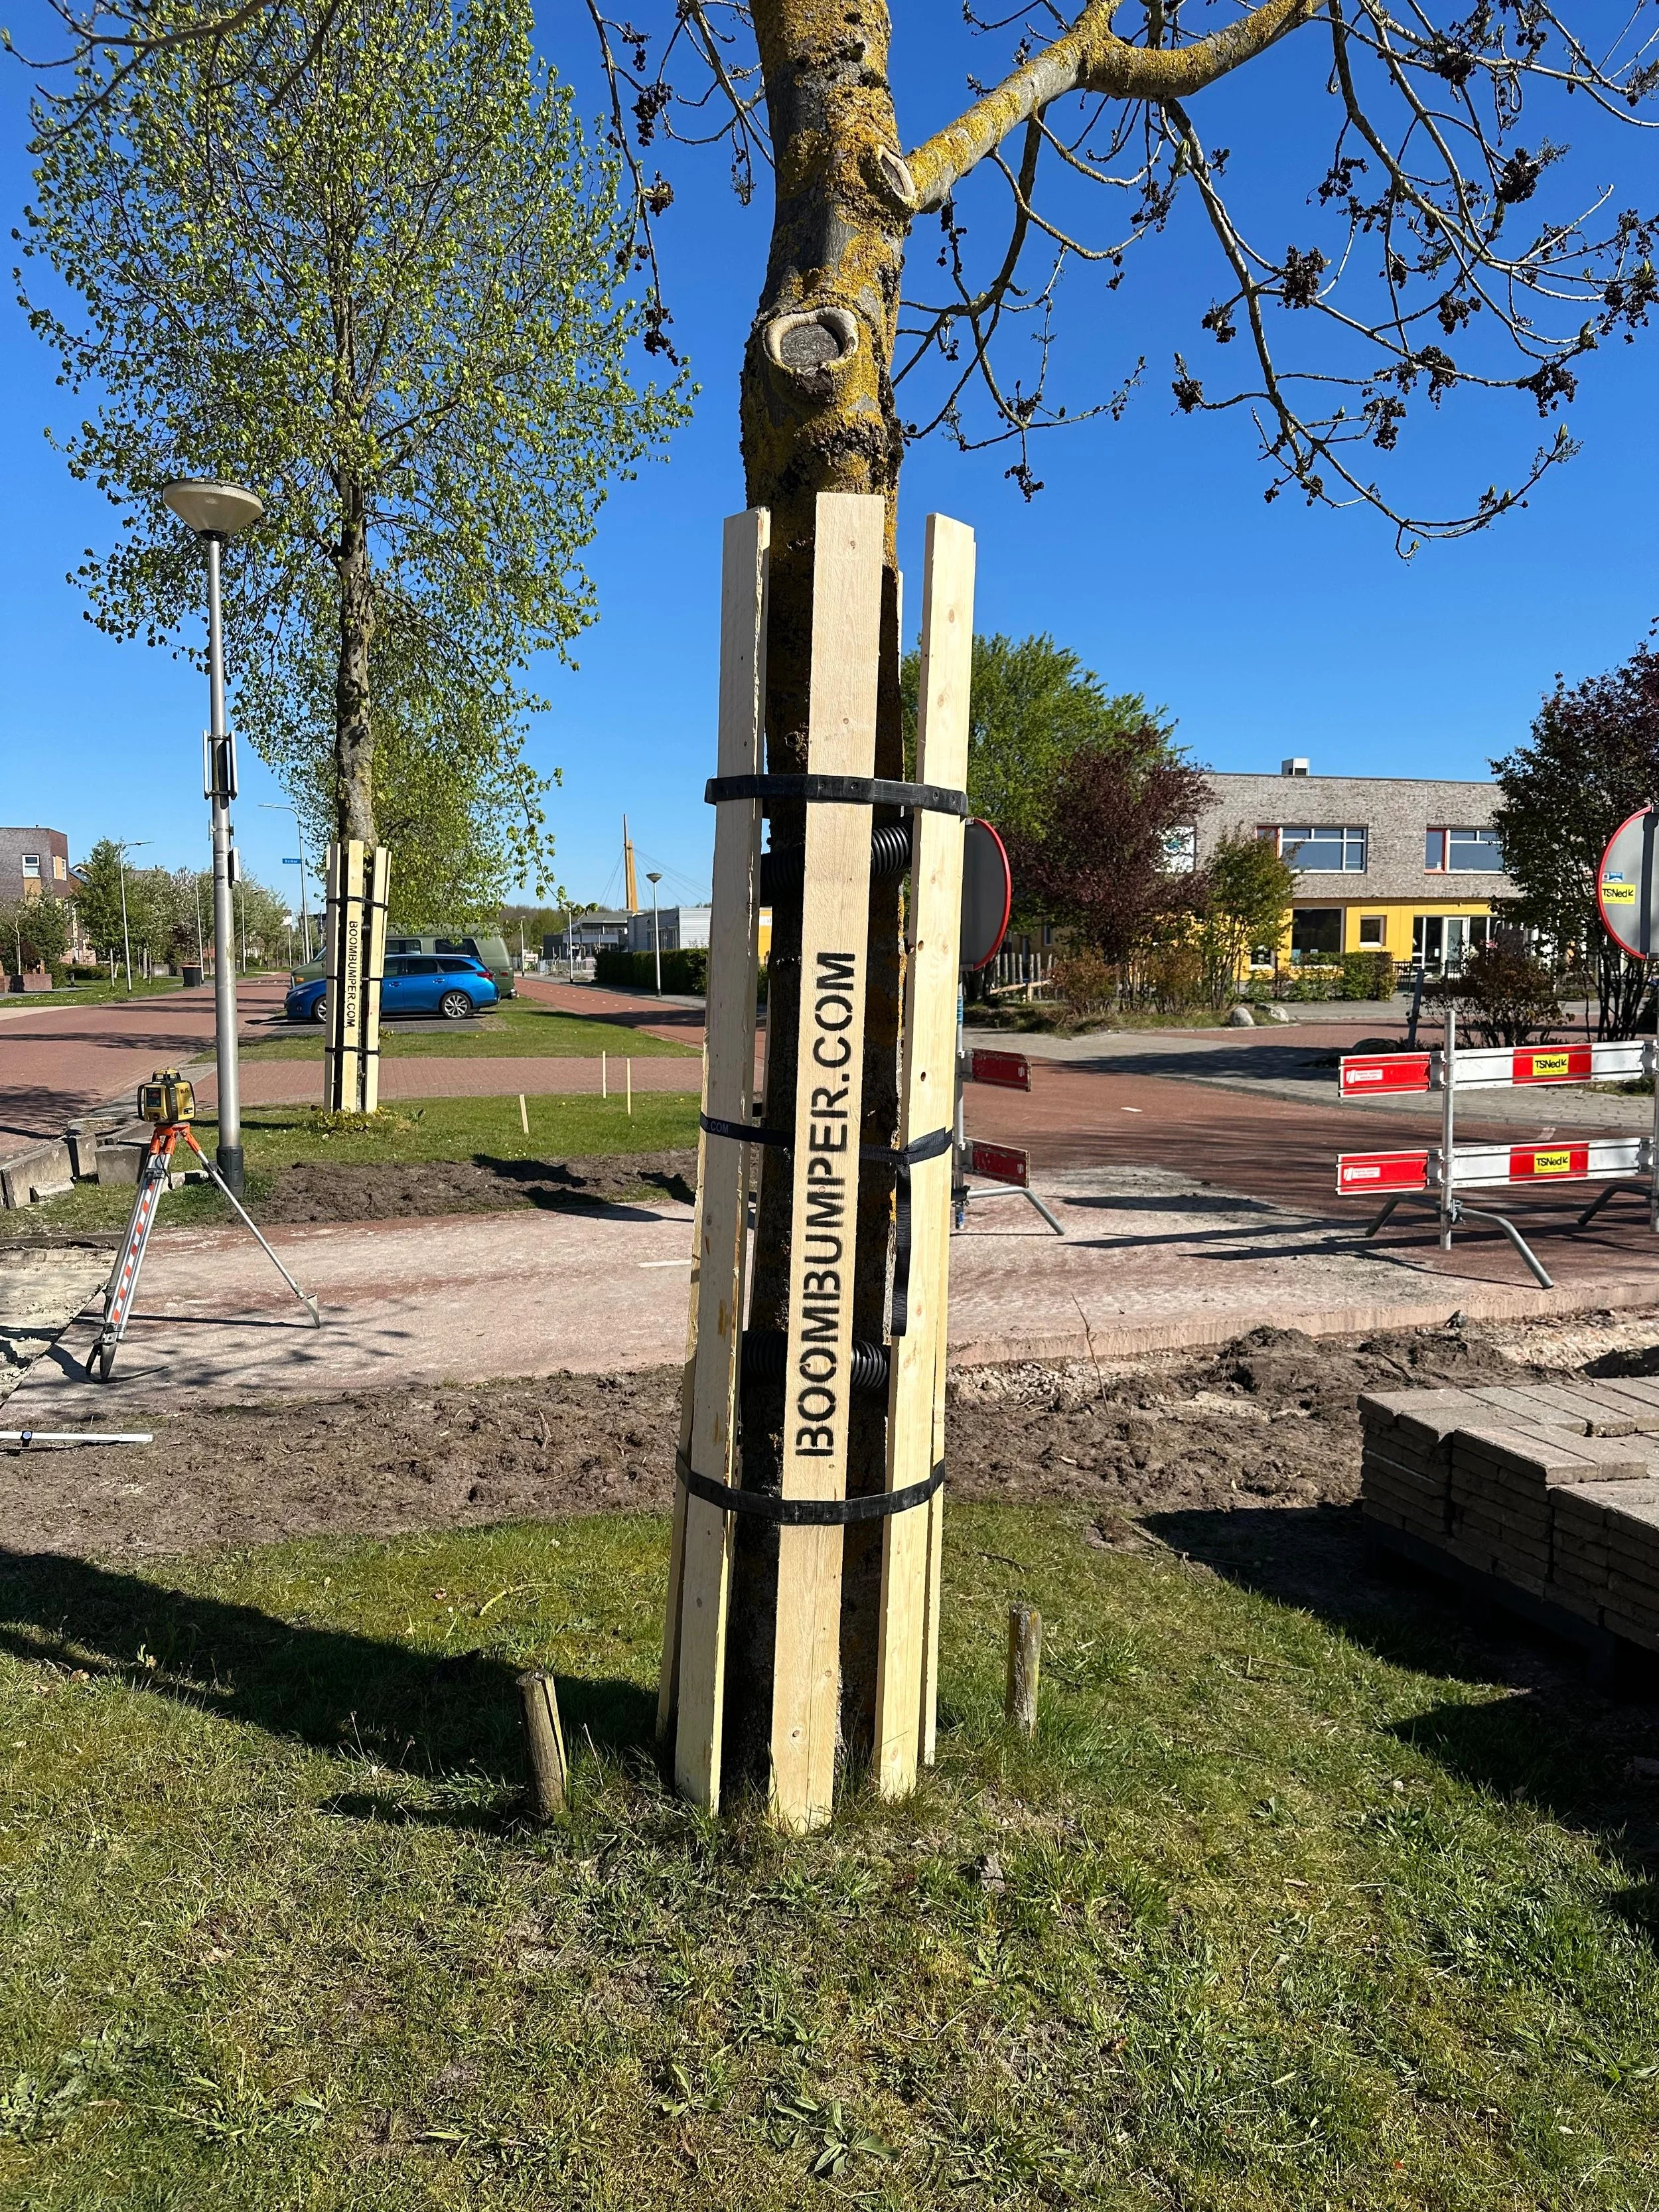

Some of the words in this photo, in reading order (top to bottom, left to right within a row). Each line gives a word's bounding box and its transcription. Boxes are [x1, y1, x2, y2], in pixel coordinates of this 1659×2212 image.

[1602, 888, 1627, 897] TSNed
[346, 921, 358, 1027] BOOMBUMPER.COM
[1534, 1059, 1560, 1069] TSNed
[1536, 1156, 1562, 1166] TSNed
[796, 952, 855, 1457] BOOMBUMPER.COM
